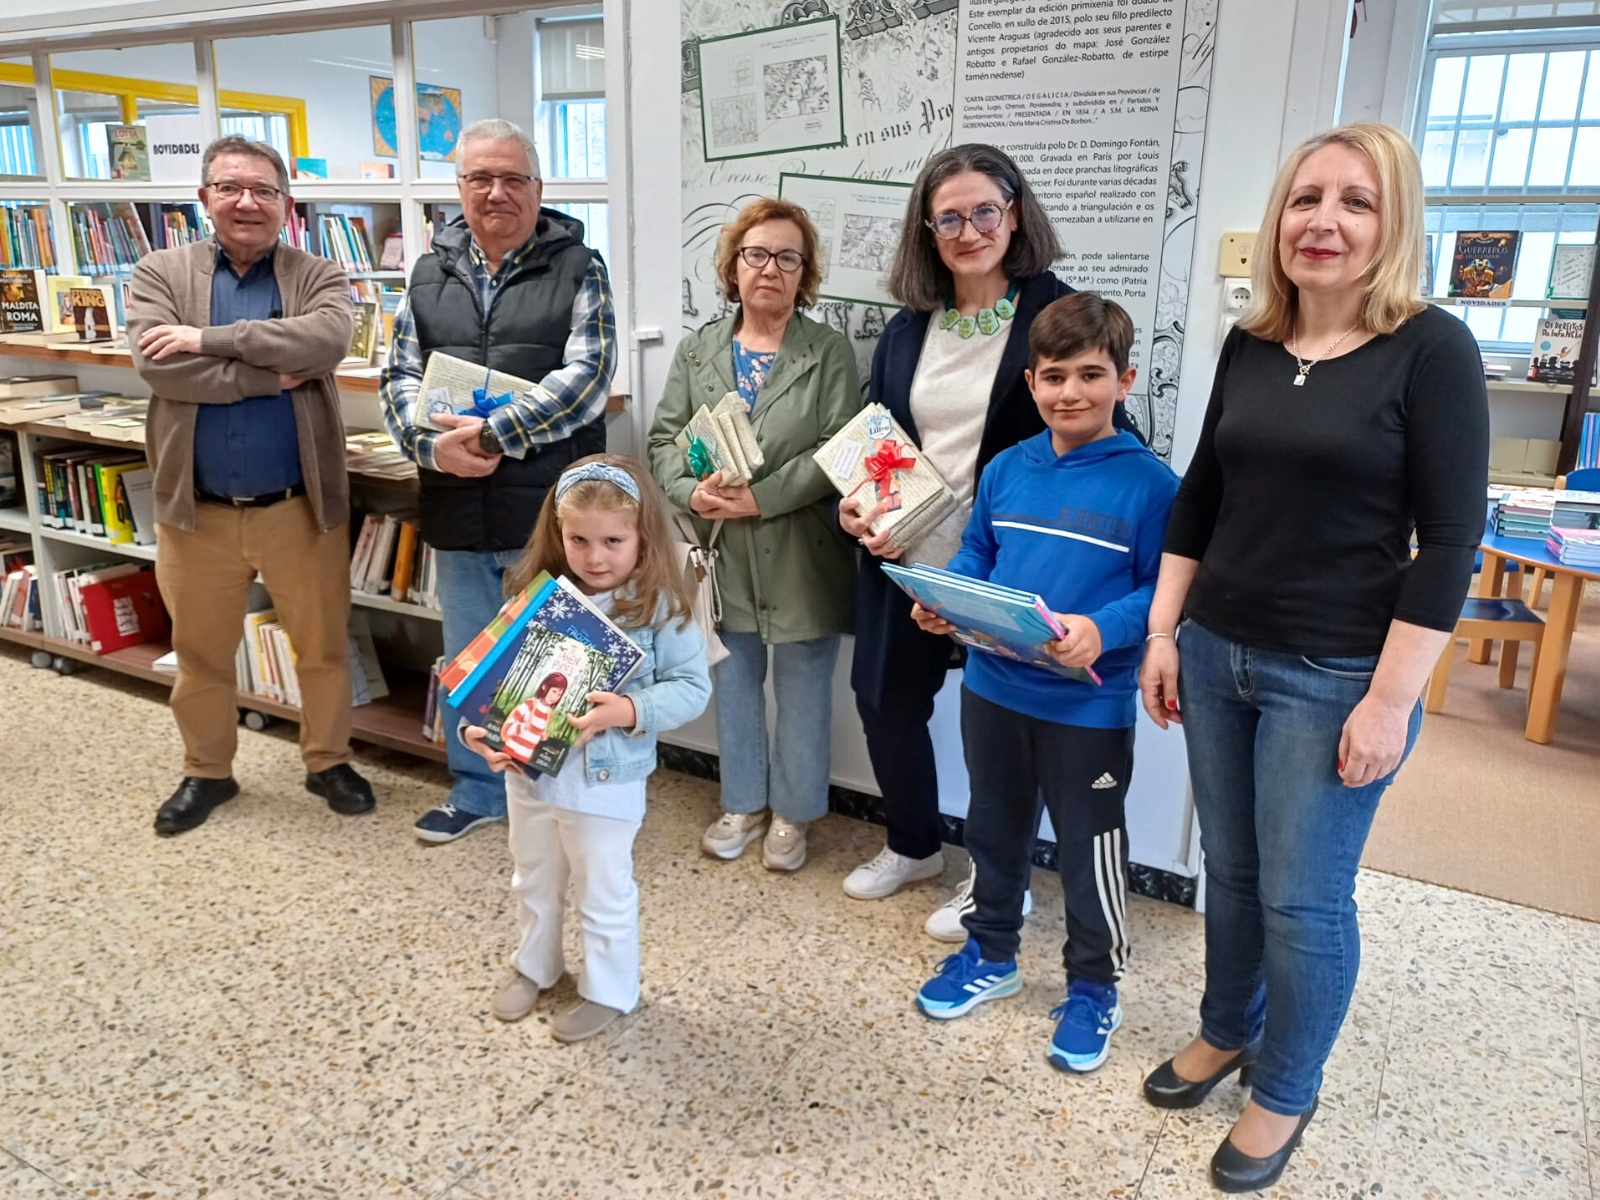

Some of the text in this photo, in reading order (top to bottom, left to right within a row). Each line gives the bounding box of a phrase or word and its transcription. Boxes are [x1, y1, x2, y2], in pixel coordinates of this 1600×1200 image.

[969, 10, 984, 18] Este
[987, 6, 1022, 17] exemplar
[1025, 5, 1036, 14] da
[1038, 2, 1067, 13] edición
[1071, 0, 1114, 12] primixenia
[968, 21, 1002, 31] Concello,
[1016, 18, 1036, 27] xullo
[1037, 17, 1048, 25] de
[1050, 15, 1071, 25] 2015,
[1073, 14, 1093, 25] polo
[1095, 13, 1109, 21] seu
[1112, 11, 1128, 20] fillo
[1129, 8, 1173, 20] predilecto
[967, 35, 996, 43] Vicente
[998, 32, 1030, 42] Araguas
[1034, 28, 1081, 41] (agradecido
[1103, 26, 1121, 34] seus
[1125, 23, 1162, 34] parentes
[1165, 22, 1172, 30] e
[966, 35, 1170, 57] antigos propietarios do mapa: José González
[966, 59, 996, 69] Robatto
[1001, 59, 1007, 67] e
[1012, 56, 1037, 65] Rafael
[1122, 50, 1134, 59] de
[1139, 49, 1169, 59] estirpe
[965, 70, 1025, 81] tamén nedense)
[153, 143, 200, 155] NOVIDADES
[1006, 141, 1047, 151] construída
[1048, 141, 1066, 151] polo
[1067, 141, 1078, 149] Dr.
[1080, 140, 1088, 148] D.
[1089, 139, 1128, 149] Domingo
[1129, 138, 1160, 148] Fontán,
[1040, 153, 1072, 162] Gravada
[1093, 152, 1112, 161] París
[1117, 153, 1132, 162] por
[1137, 151, 1160, 160] Louis
[1054, 166, 1074, 174] doce
[1075, 165, 1111, 175] pranchas
[1113, 163, 1158, 175] litográficas
[1053, 178, 1065, 186] Foi
[1067, 178, 1098, 186] durante
[1098, 177, 1122, 186] varias
[1123, 176, 1157, 186] décadas
[1065, 190, 1097, 200] español
[1100, 189, 1137, 198] realizado
[1080, 202, 1133, 213] triangulación
[1136, 203, 1142, 211] e
[1050, 215, 1095, 223] comezaban
[1104, 214, 1141, 223] utilizarse
[1458, 245, 1509, 255] GUERREROS
[1081, 251, 1103, 261] pode
[1106, 251, 1150, 261] salientarse
[1109, 264, 1149, 273] admirado
[1096, 277, 1119, 285] como
[1121, 276, 1147, 286] (Patria
[1124, 289, 1146, 298] Porta
[1, 301, 39, 310] MALDITA
[72, 296, 105, 308] KING
[1460, 299, 1507, 307] NOVIDADES
[6, 312, 39, 322] ROMA
